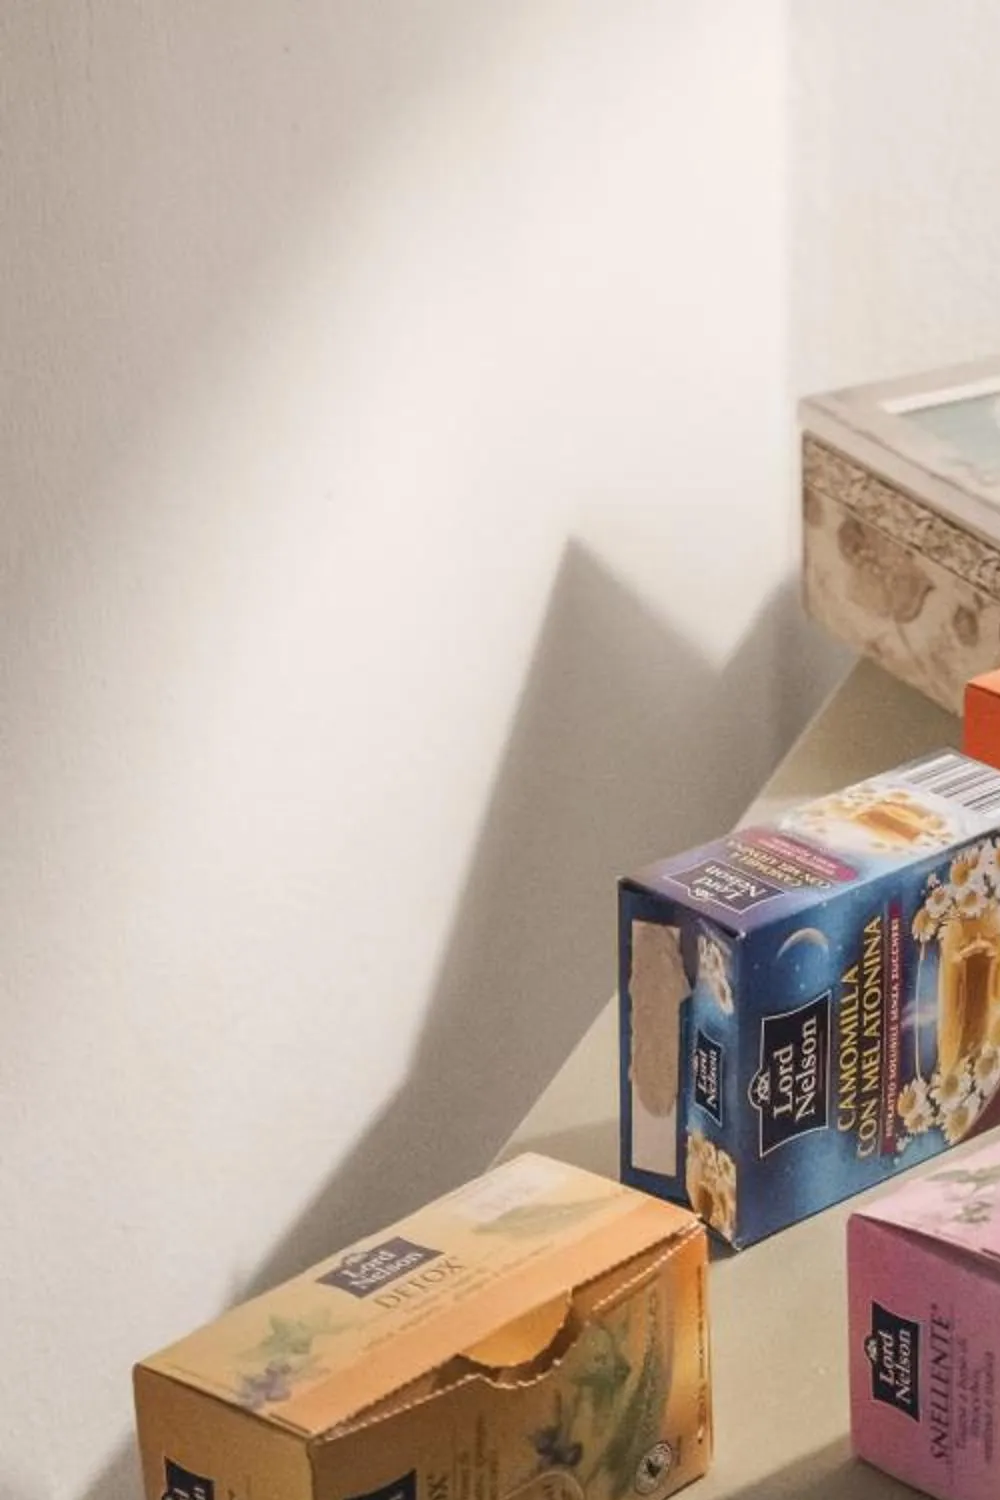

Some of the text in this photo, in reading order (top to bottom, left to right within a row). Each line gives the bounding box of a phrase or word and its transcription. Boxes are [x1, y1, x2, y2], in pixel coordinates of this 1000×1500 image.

[795, 1015, 818, 1123] Nelson
[837, 964, 860, 1132] CAMOMILLA
[856, 915, 883, 1158] CON MELATONINA
[773, 1042, 794, 1119] Lord
[342, 1250, 396, 1278] Lord
[350, 1252, 424, 1290] Nelson
[879, 1330, 895, 1386] Lord
[895, 1329, 912, 1405] Nelson
[930, 1315, 951, 1459] SNELLENTE
